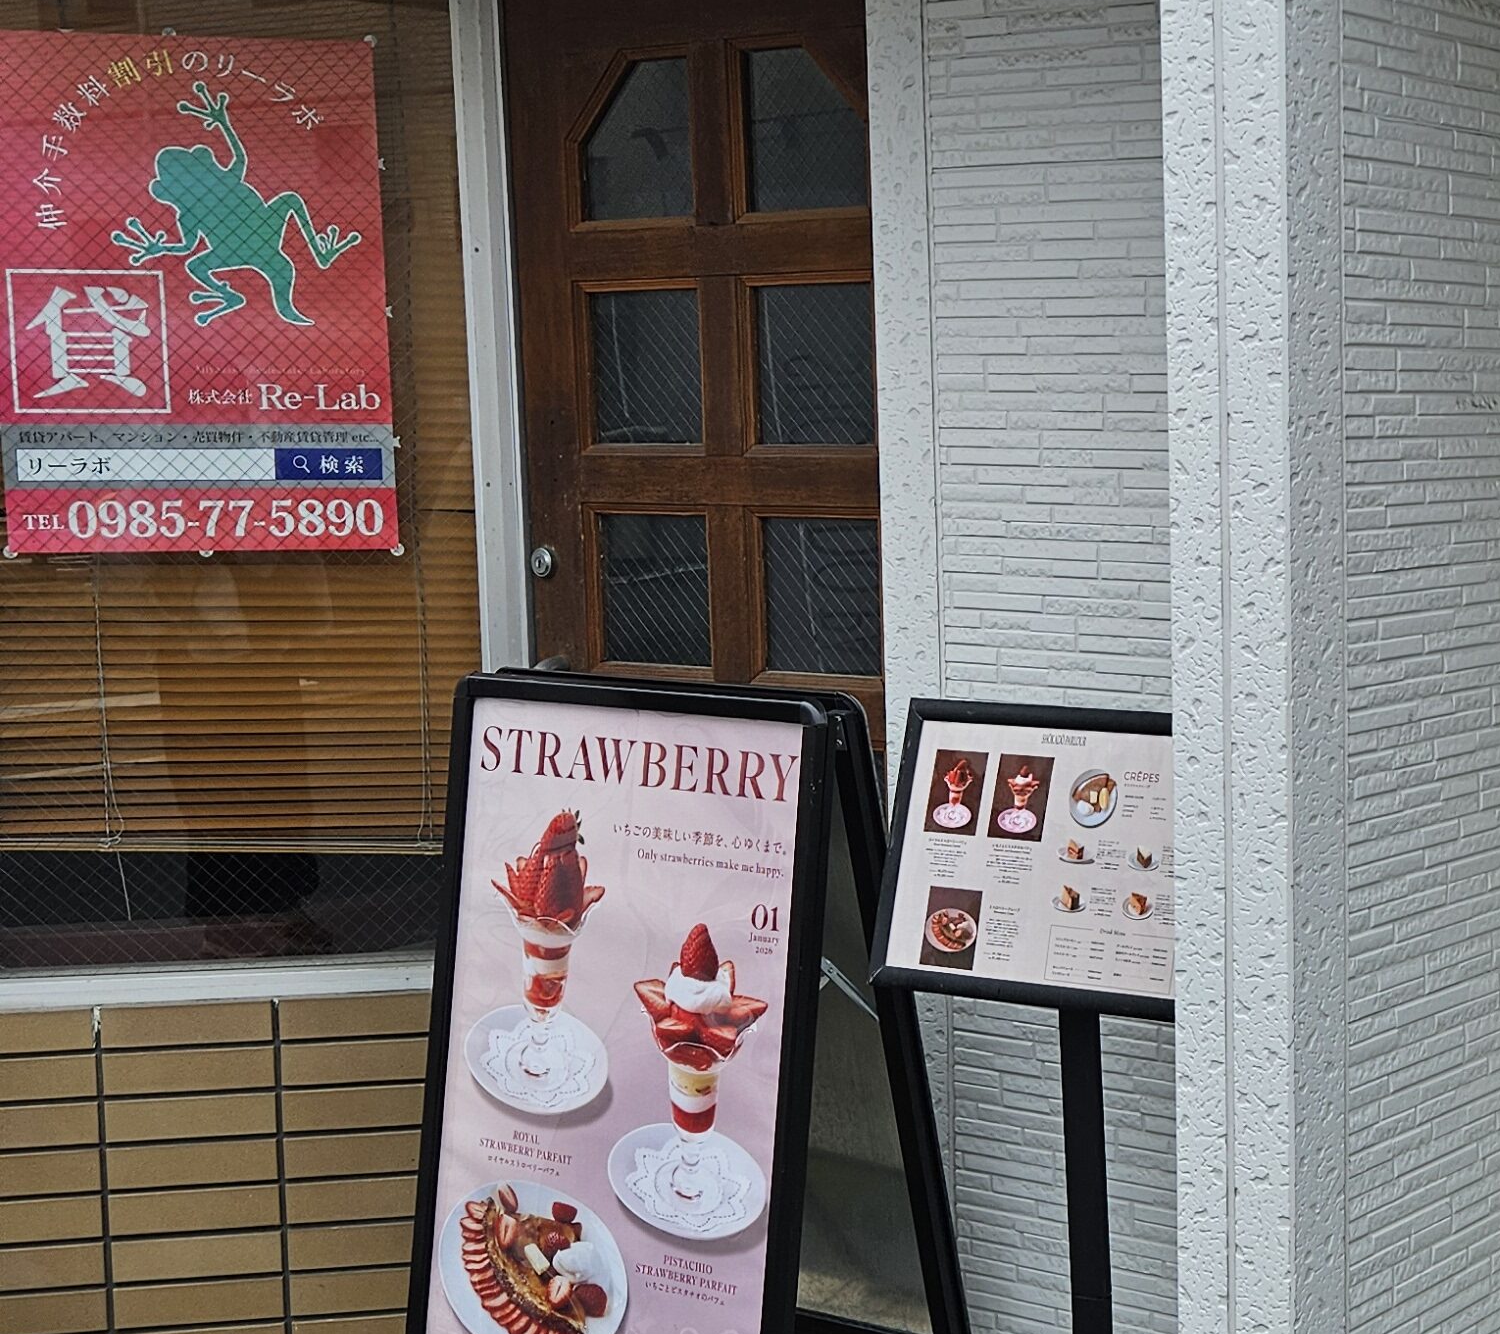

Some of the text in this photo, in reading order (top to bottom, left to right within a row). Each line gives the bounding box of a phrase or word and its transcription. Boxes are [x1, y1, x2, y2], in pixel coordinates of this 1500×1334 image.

[32, 49, 325, 231] 仲介手数料割引のリーラボ
[24, 285, 152, 400] 貸
[187, 382, 382, 411] 株式会社 Re-Lab
[28, 455, 112, 475] リーラボ
[318, 454, 365, 475] 検索
[23, 498, 385, 539] TEL 0985-77-5890
[480, 725, 799, 802] STRAWBERRY
[1123, 770, 1160, 783] CRÊPES
[613, 823, 787, 856] いちごの美味しい季節を、心ゆくまで。
[637, 848, 784, 879] Only strawberries make me happy.
[751, 903, 780, 932] 01
[748, 932, 780, 946] January
[479, 1137, 573, 1166] STRAWBERRY PARFAIT
[512, 1130, 540, 1145] ROYAL
[663, 1254, 713, 1275] PISTACHIO
[635, 1263, 738, 1296] STRAWBERRY PARFAIT
